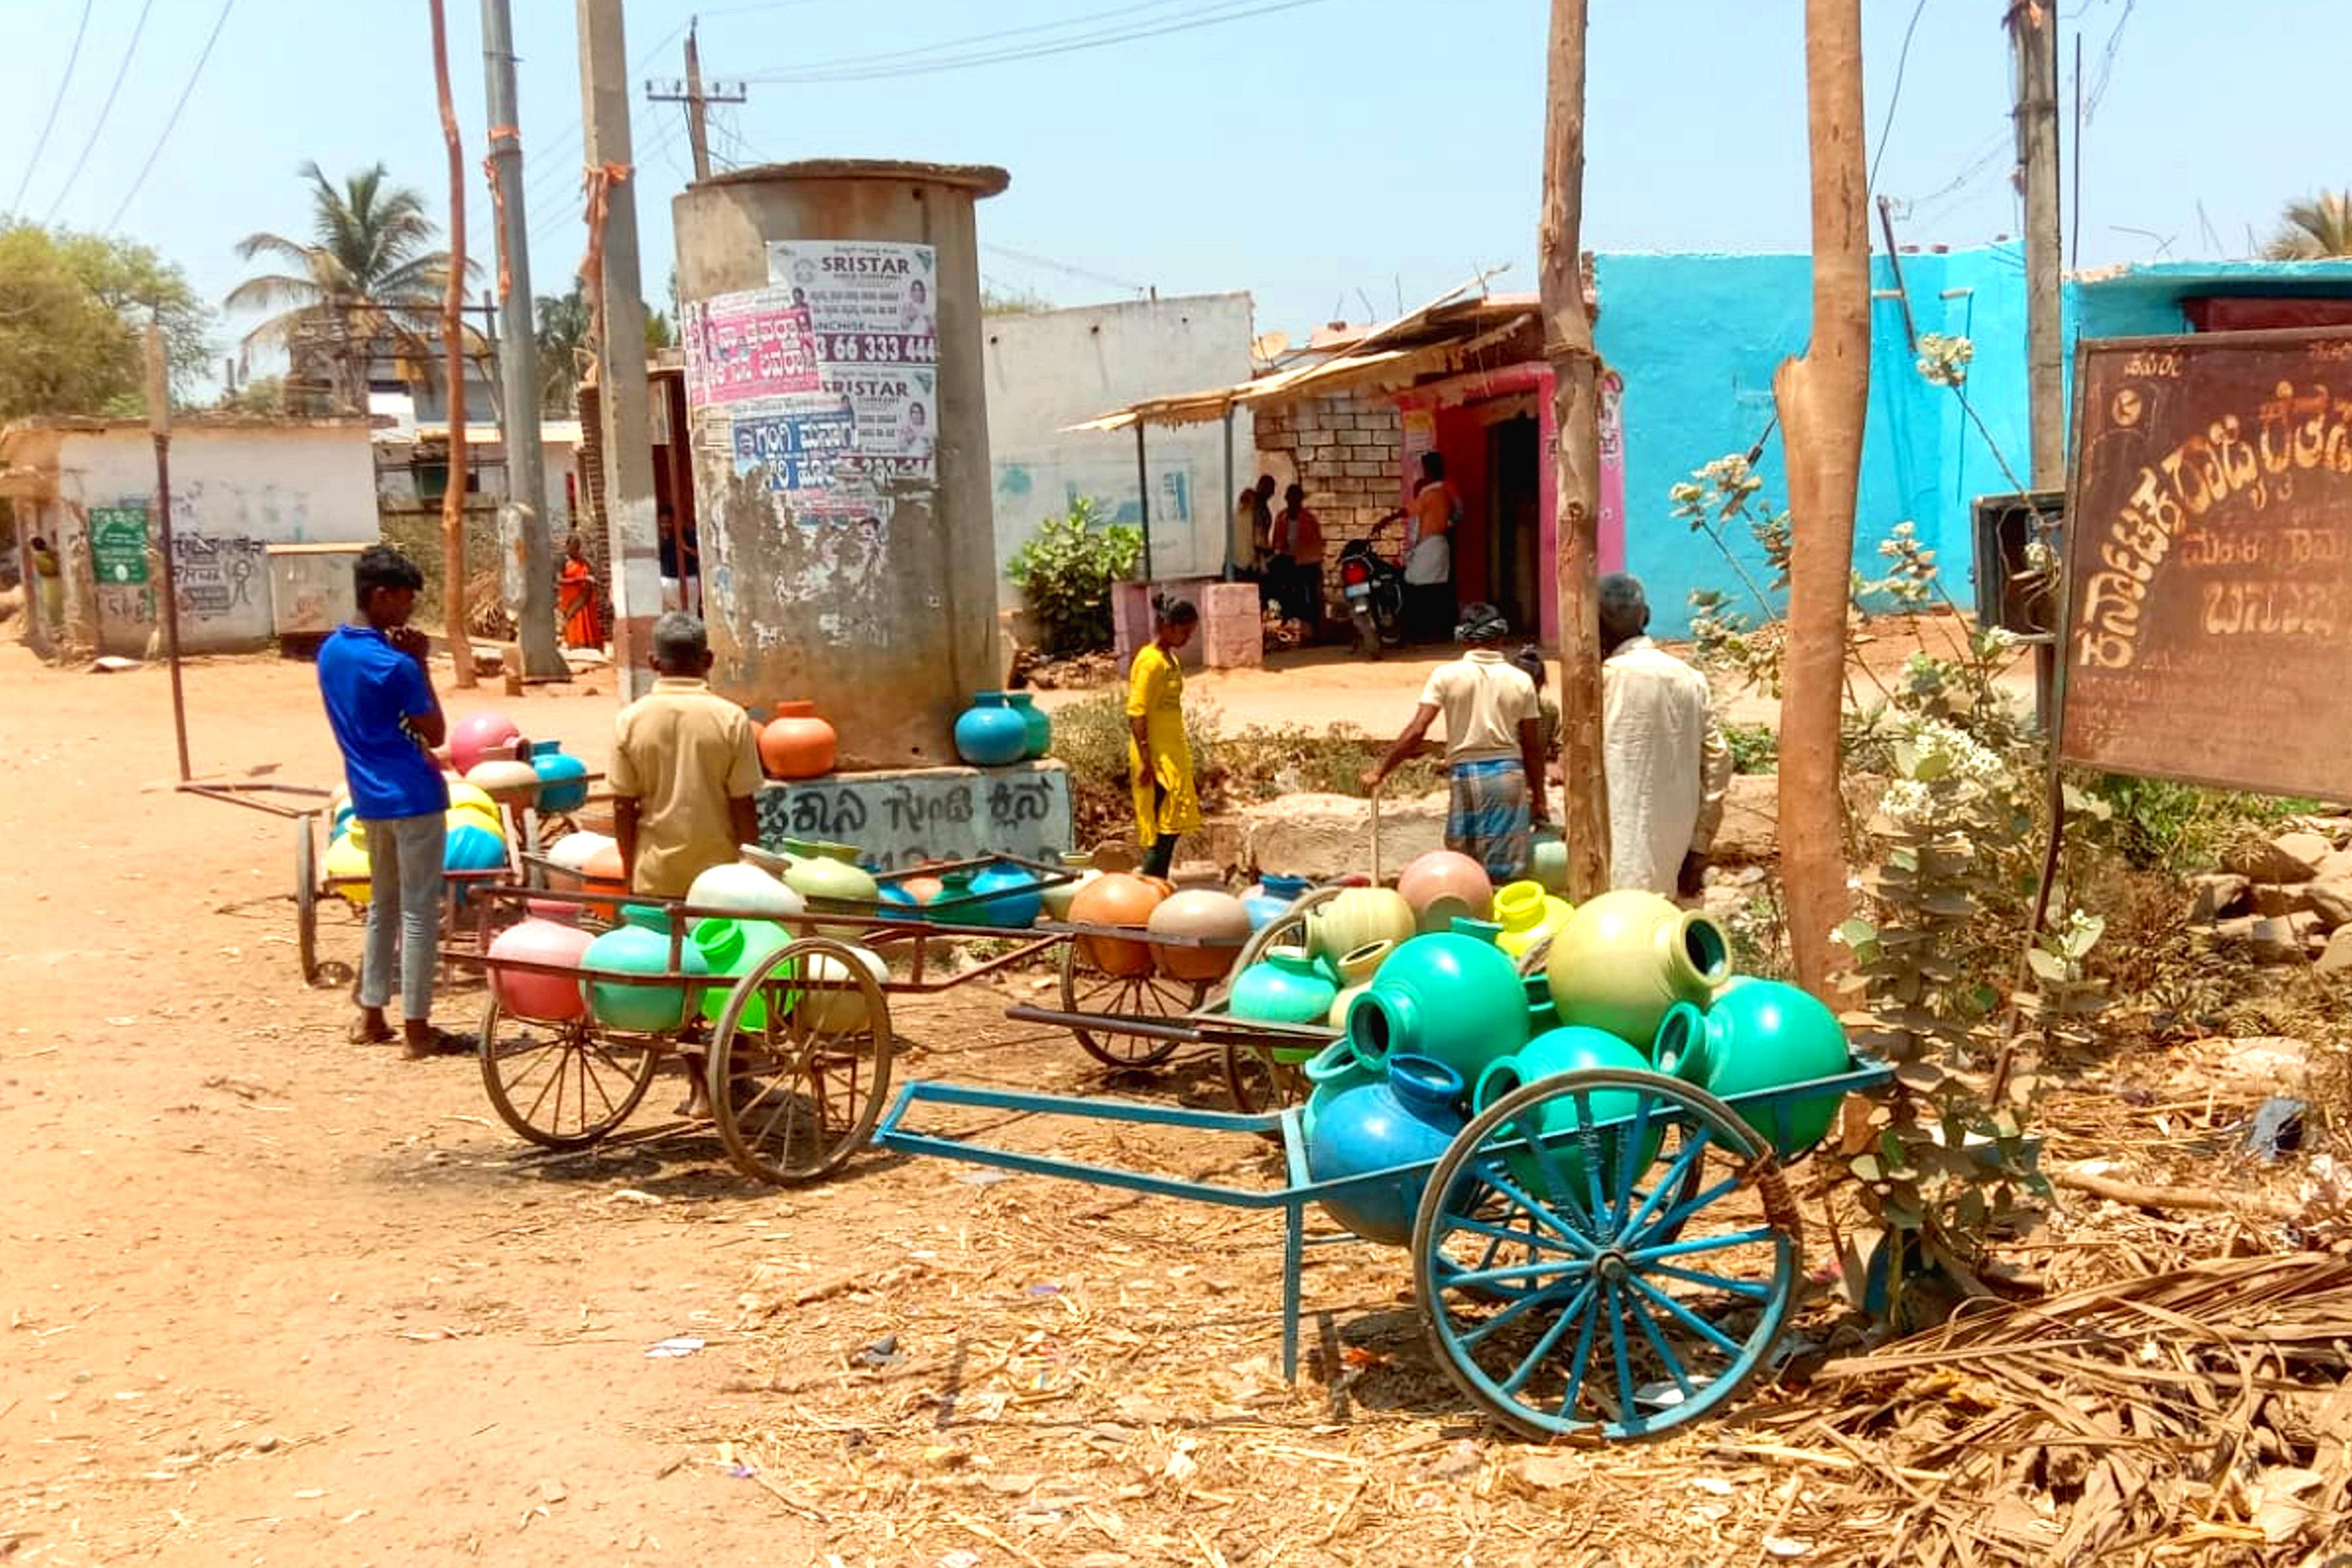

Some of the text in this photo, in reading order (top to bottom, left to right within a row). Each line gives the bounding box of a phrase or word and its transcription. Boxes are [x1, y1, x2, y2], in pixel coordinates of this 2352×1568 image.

[822, 257, 910, 274] SRISTAR
[833, 336, 858, 361] 66
[864, 336, 899, 361] 333
